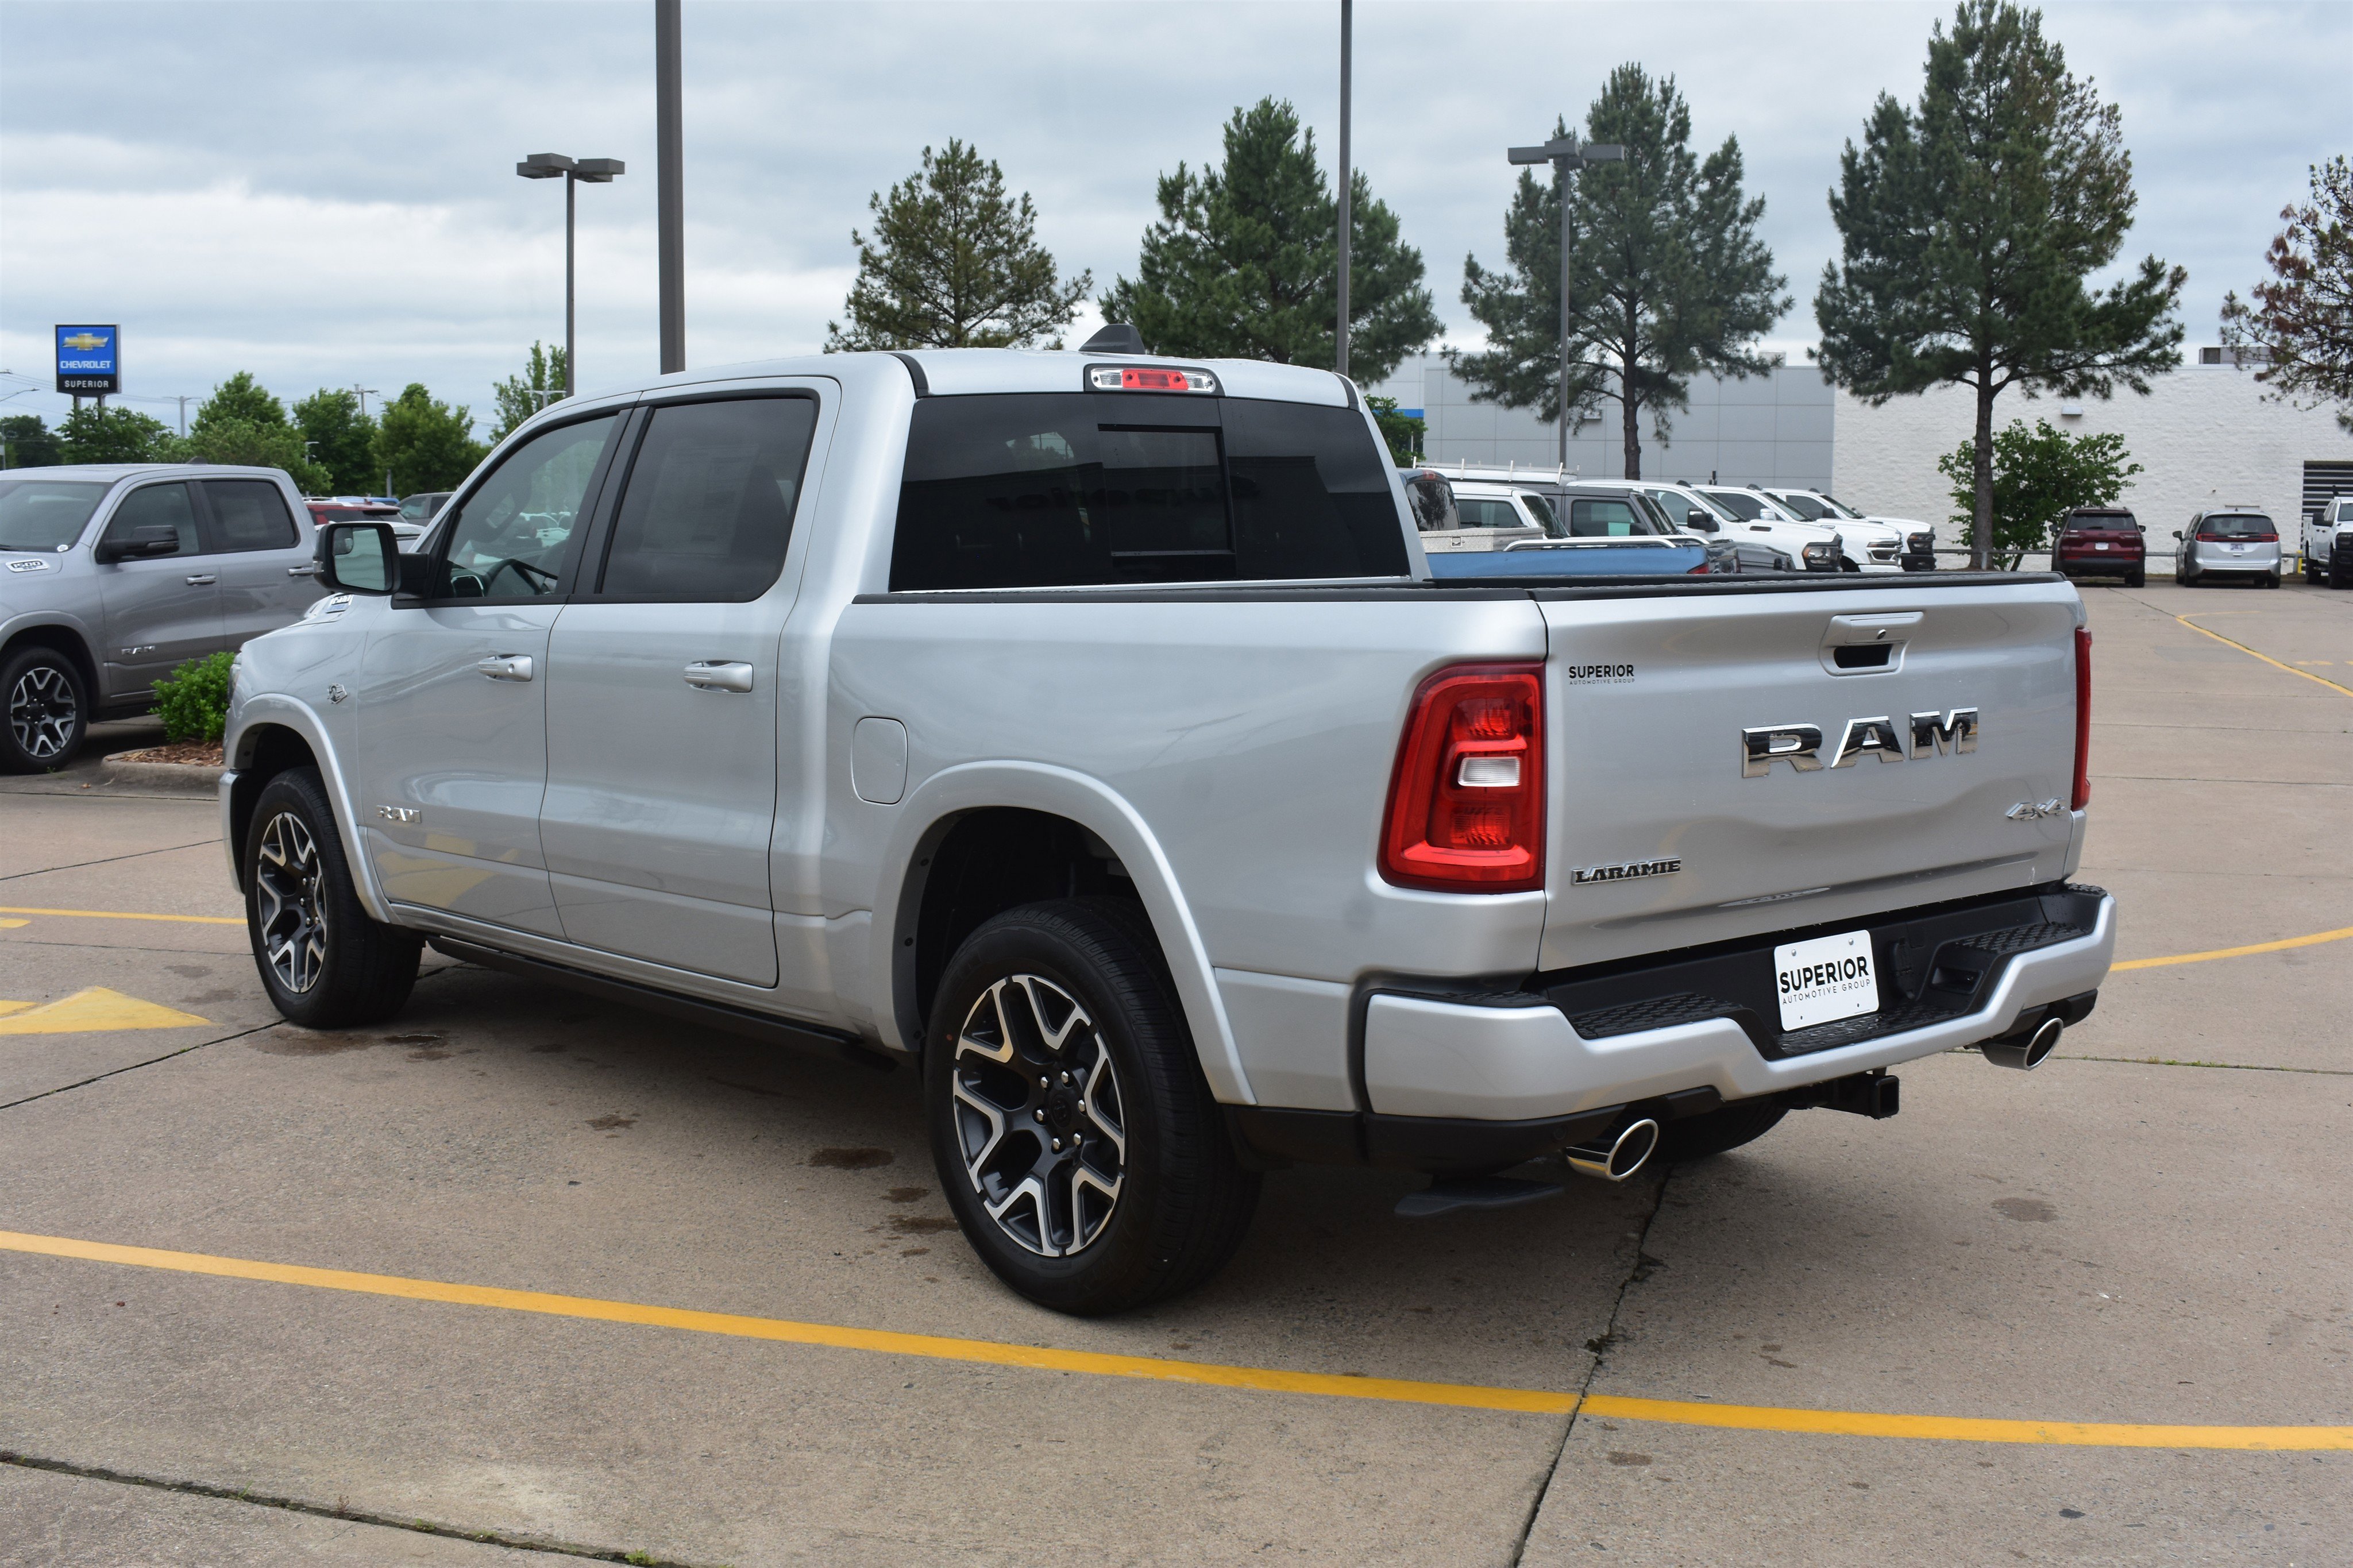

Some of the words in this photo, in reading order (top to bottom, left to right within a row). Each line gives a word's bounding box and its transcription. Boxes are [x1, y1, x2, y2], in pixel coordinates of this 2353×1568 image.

[1569, 665, 1634, 678] SUPERIOR
[1742, 707, 1978, 778] RAM
[377, 805, 422, 822] RAM
[1571, 858, 1682, 885] LARAMIE
[1780, 956, 1869, 994] SUPERIOR
[1782, 986, 1837, 1005] AUTOMOTIVE
[1842, 978, 1871, 992] GROUP
